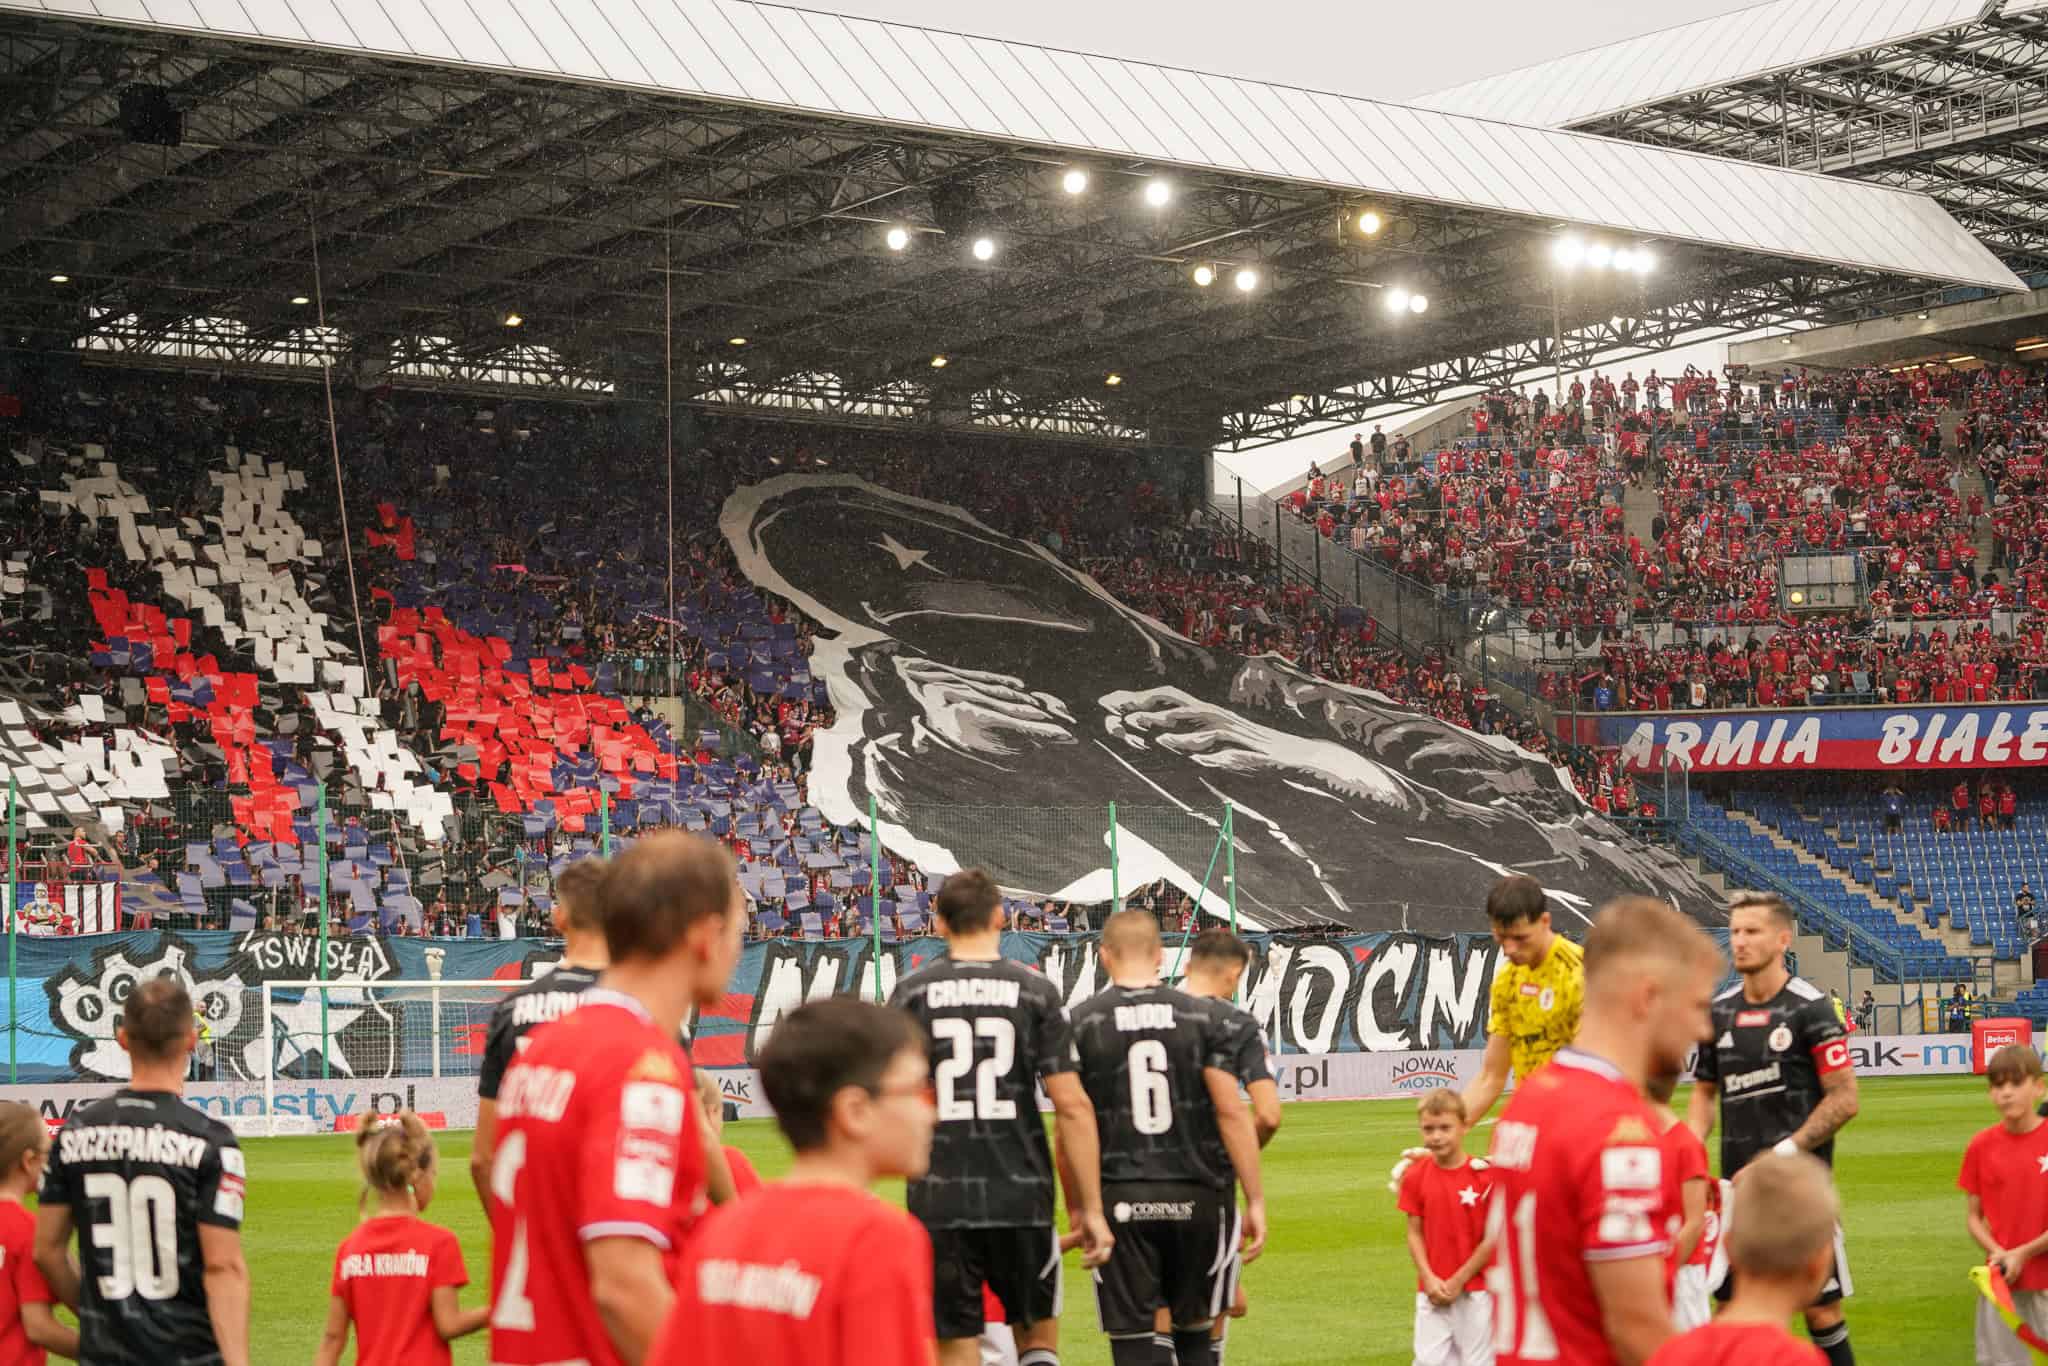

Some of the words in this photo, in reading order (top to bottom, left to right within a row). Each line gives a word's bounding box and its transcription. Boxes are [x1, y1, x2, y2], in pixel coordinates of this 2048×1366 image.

[1616, 716, 1821, 770] ARMIA
[931, 1017, 1017, 1122] 22
[1393, 1056, 1457, 1078] NOWAK
[1825, 1043, 1847, 1067] C
[1128, 1039, 1174, 1135] 6
[1399, 1076, 1450, 1089] MOSTY
[60, 1122, 207, 1170] SZCZEPAŃSKI
[82, 1173, 180, 1301] 30
